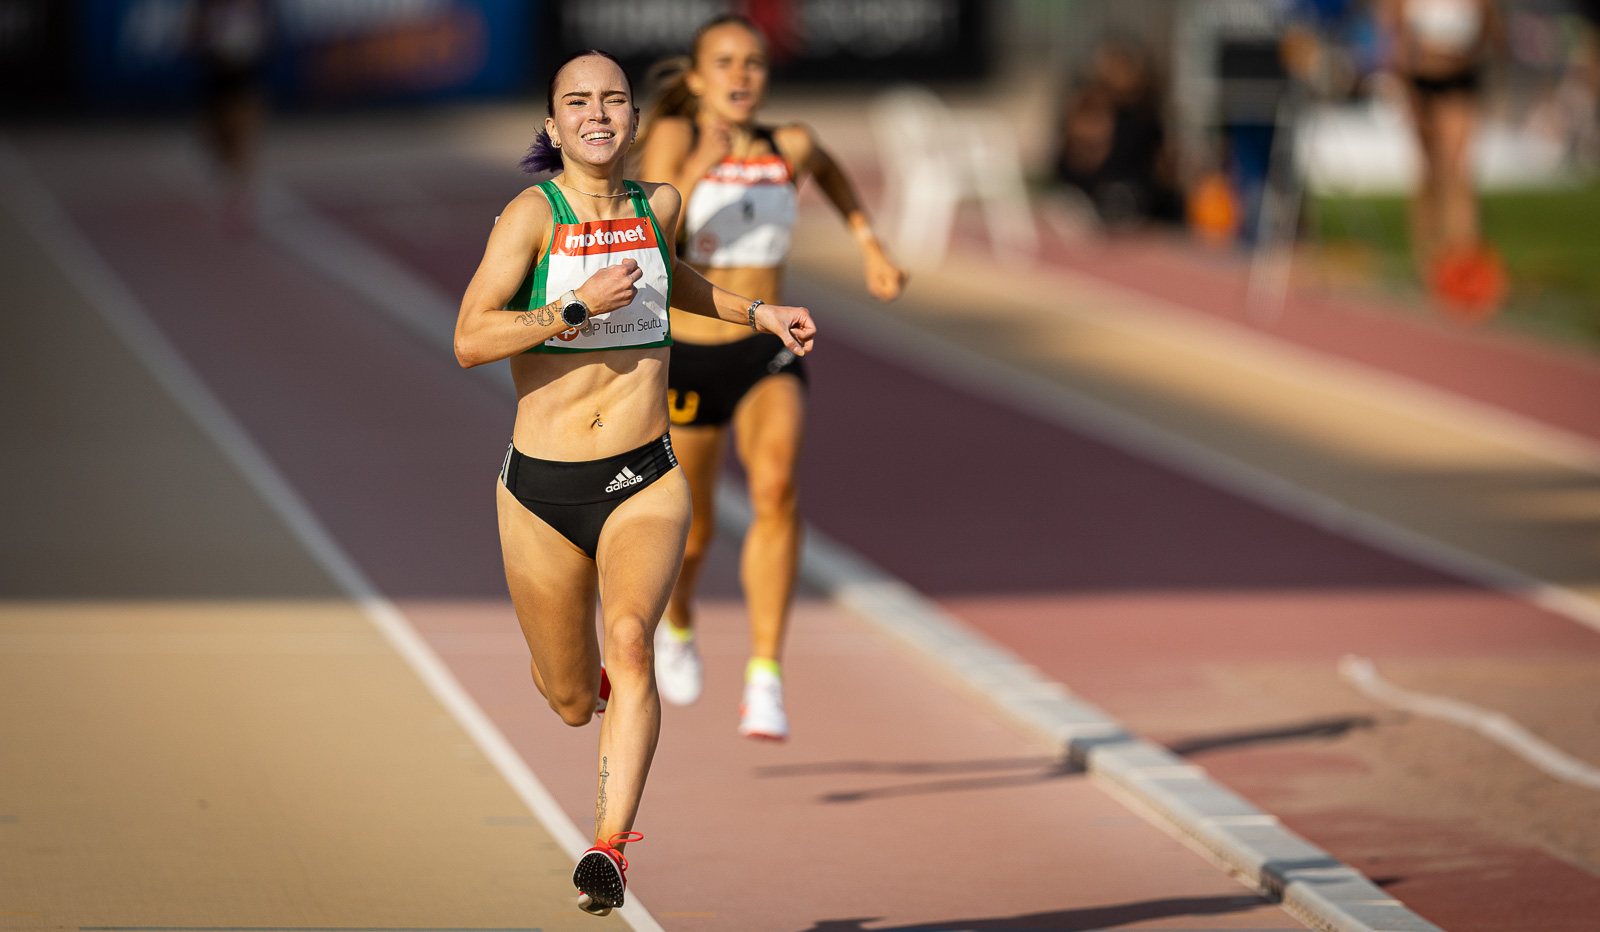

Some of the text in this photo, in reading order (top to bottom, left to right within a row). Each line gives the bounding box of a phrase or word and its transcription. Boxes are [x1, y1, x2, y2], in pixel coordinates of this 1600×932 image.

[565, 225, 646, 249] motonet
[603, 322, 635, 335] Turun
[637, 318, 662, 332] Seutu
[605, 475, 643, 493] adidas
